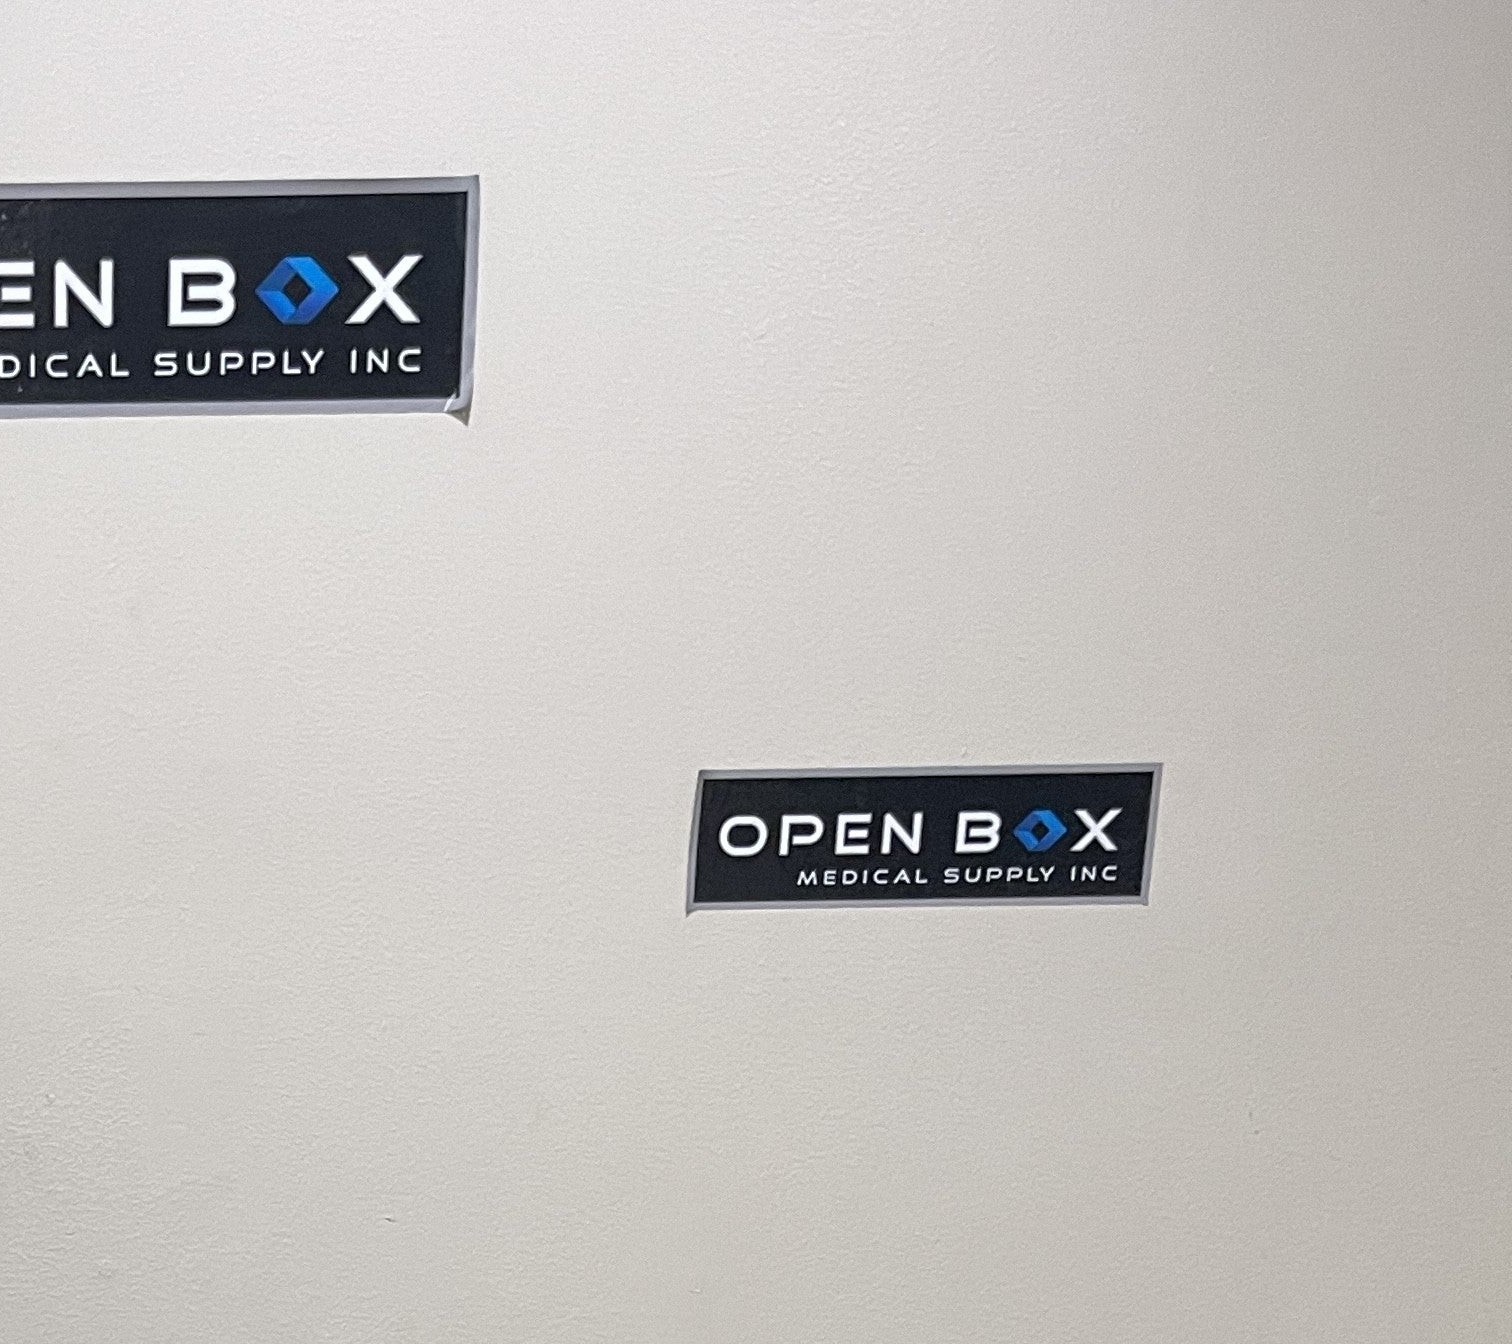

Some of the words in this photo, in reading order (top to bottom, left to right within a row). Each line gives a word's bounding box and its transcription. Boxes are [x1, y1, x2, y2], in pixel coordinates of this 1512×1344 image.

[168, 254, 423, 327] BOX
[154, 348, 325, 377] SUPPLY
[350, 347, 422, 374] INC
[719, 811, 924, 857] OPEN
[954, 808, 1122, 854] BOX
[796, 869, 928, 886] MEDICAL
[943, 865, 1055, 884] SUPPLY
[1070, 865, 1118, 882] INC
